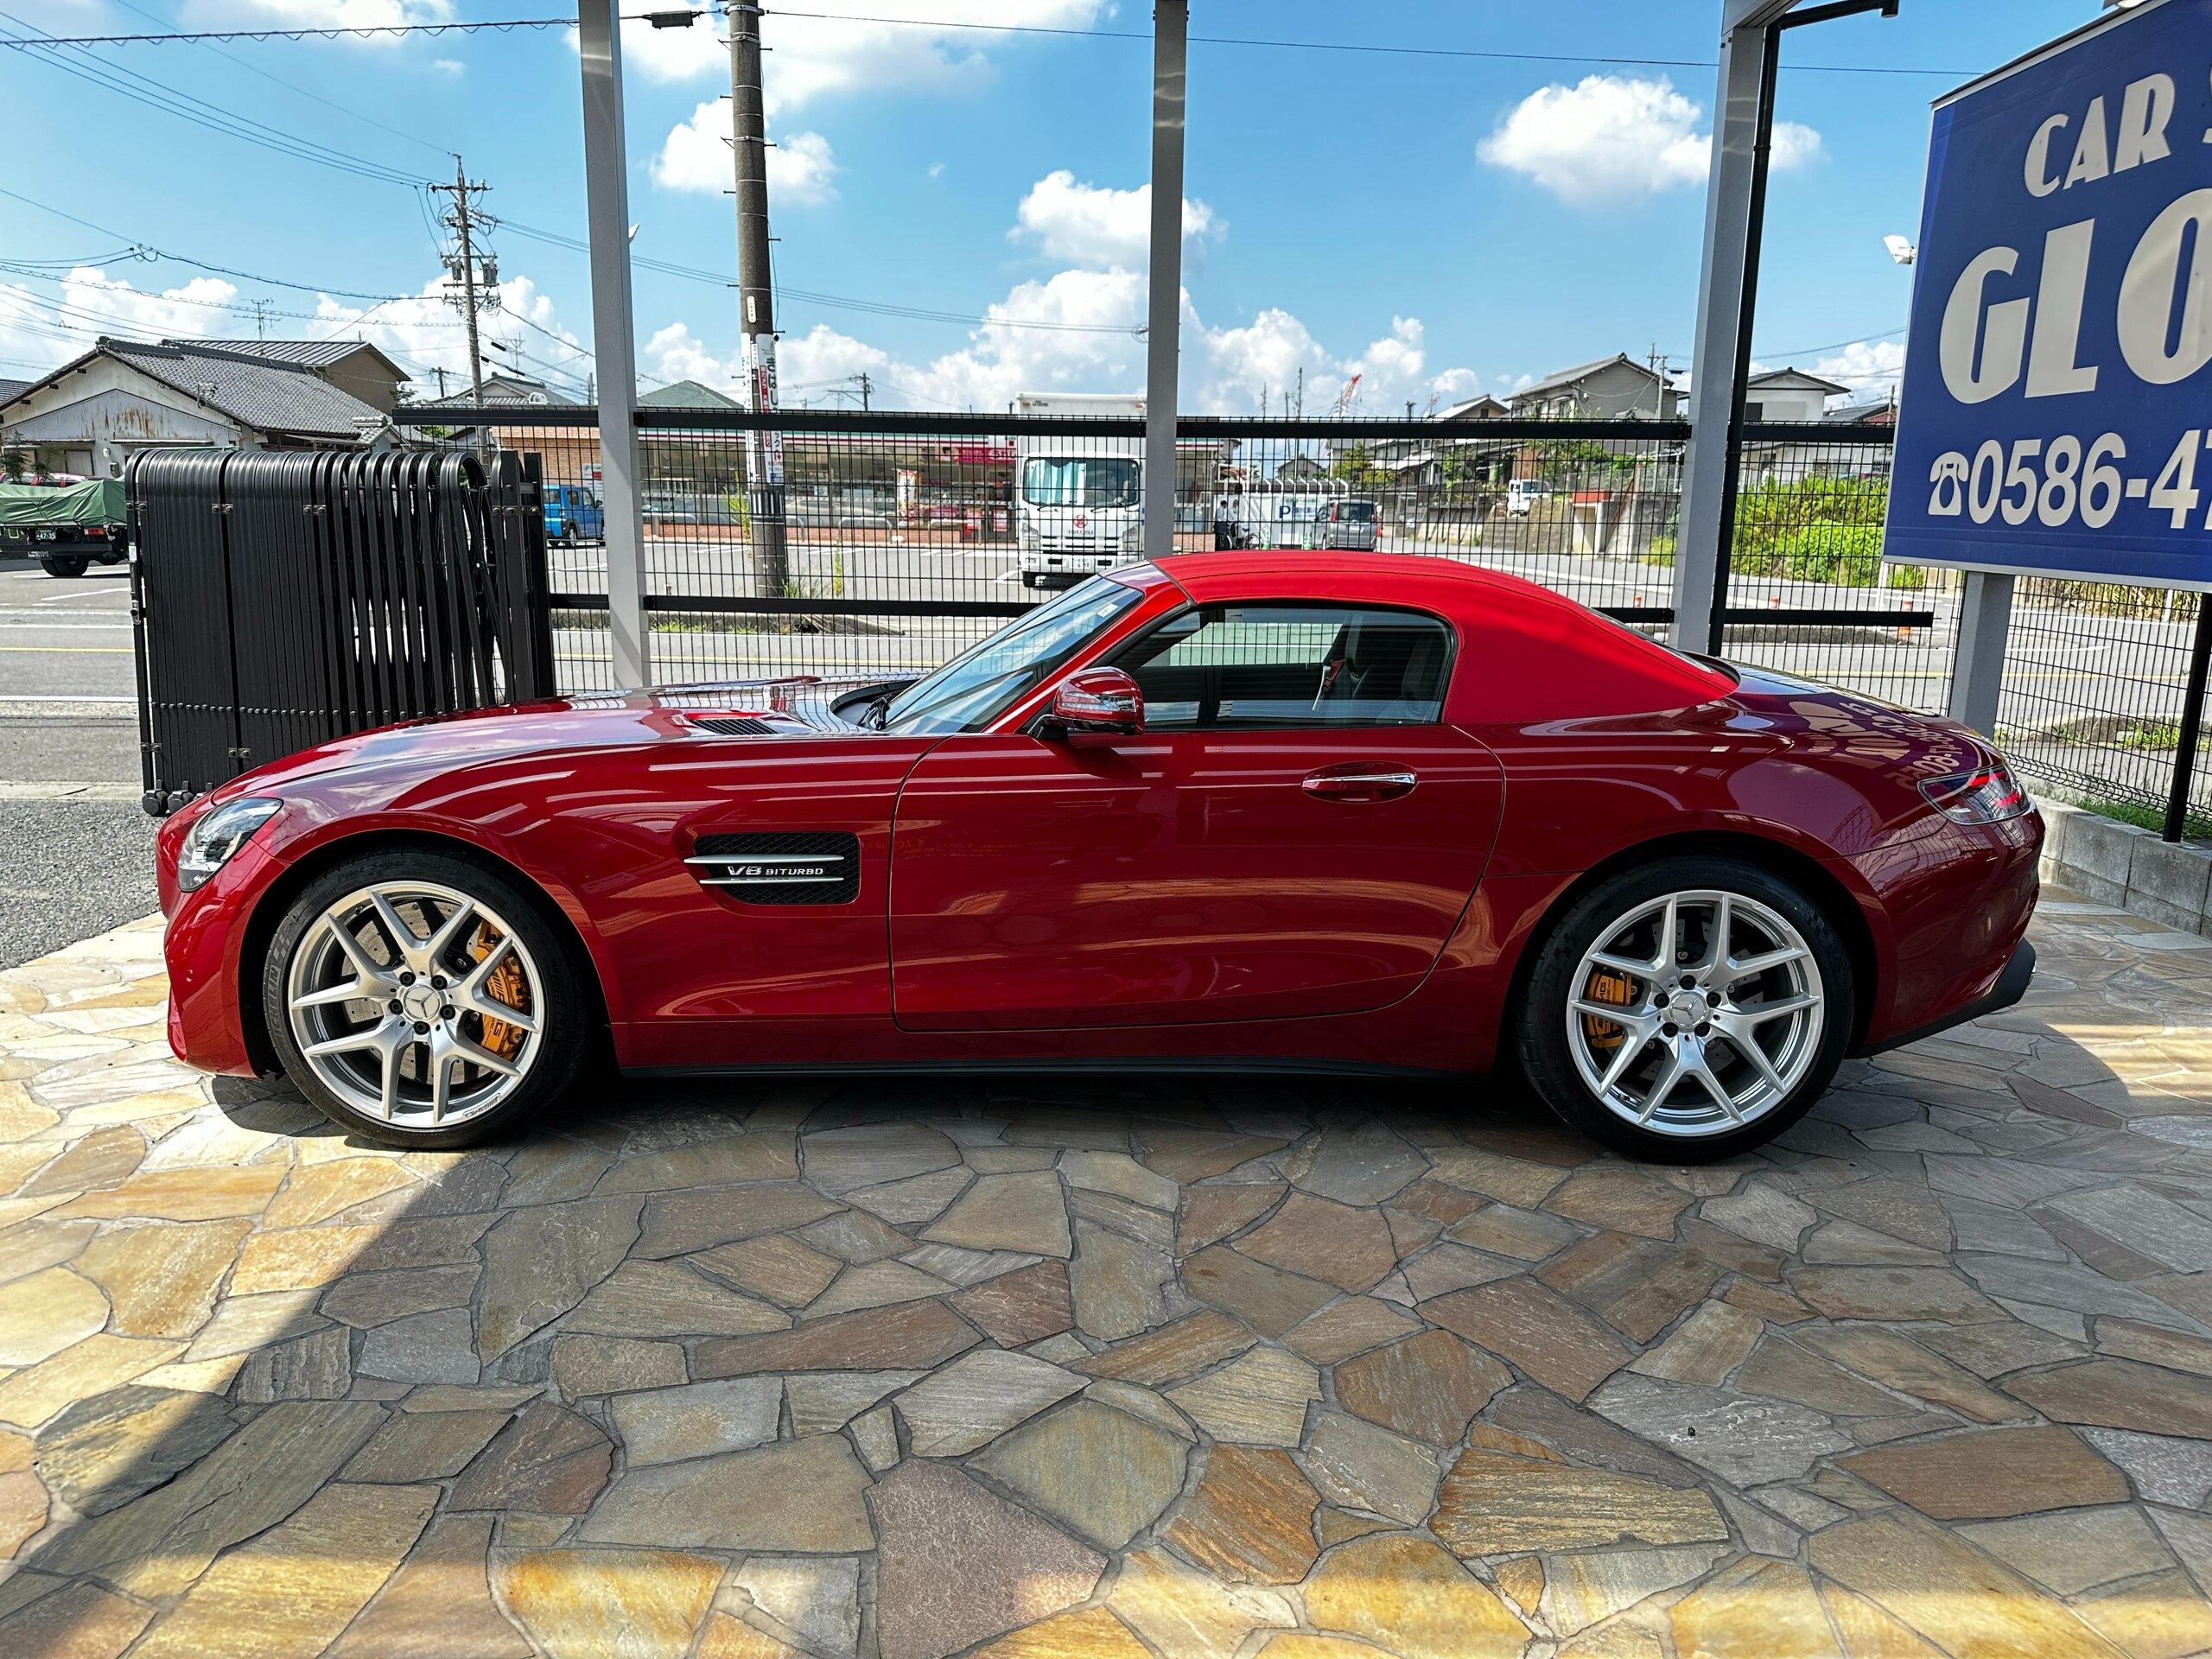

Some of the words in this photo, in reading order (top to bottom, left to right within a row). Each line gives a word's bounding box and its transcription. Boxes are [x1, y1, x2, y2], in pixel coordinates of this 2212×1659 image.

[2024, 73, 2175, 197] CAR
[1940, 188, 2212, 404] GLO
[1969, 429, 2212, 529] 0586-4
[728, 866, 762, 875] V8
